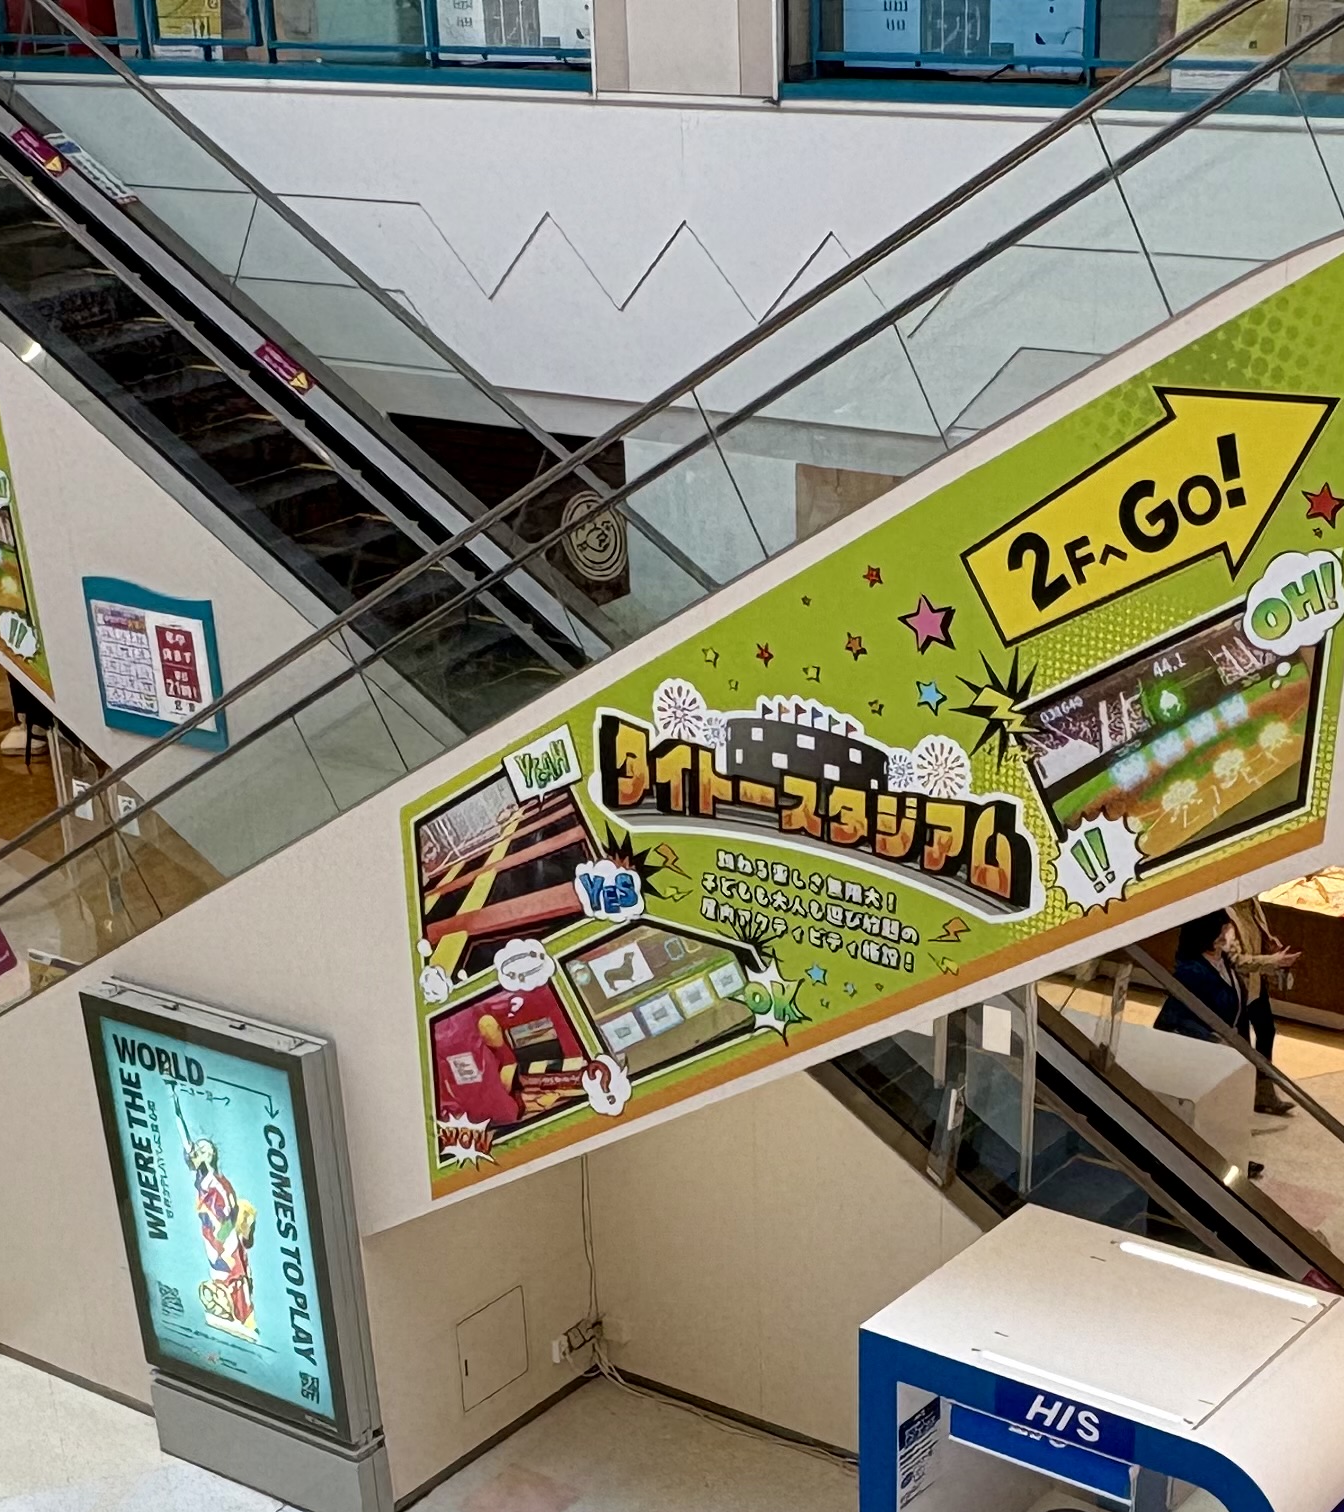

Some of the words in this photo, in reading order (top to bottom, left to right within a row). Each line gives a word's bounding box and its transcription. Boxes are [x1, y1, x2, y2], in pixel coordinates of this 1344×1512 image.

[1251, 561, 1340, 641] OH!
[606, 715, 1022, 903] タイトースタジアム
[579, 872, 640, 914] YES
[744, 979, 802, 1023] OK
[112, 1033, 205, 1087] WORLD
[119, 1067, 149, 1130] THE
[130, 1132, 169, 1241] WHERE
[263, 1124, 298, 1242] COMES
[282, 1245, 305, 1287] TO
[286, 1287, 318, 1367] PLAY
[1025, 1394, 1100, 1443] HIS
